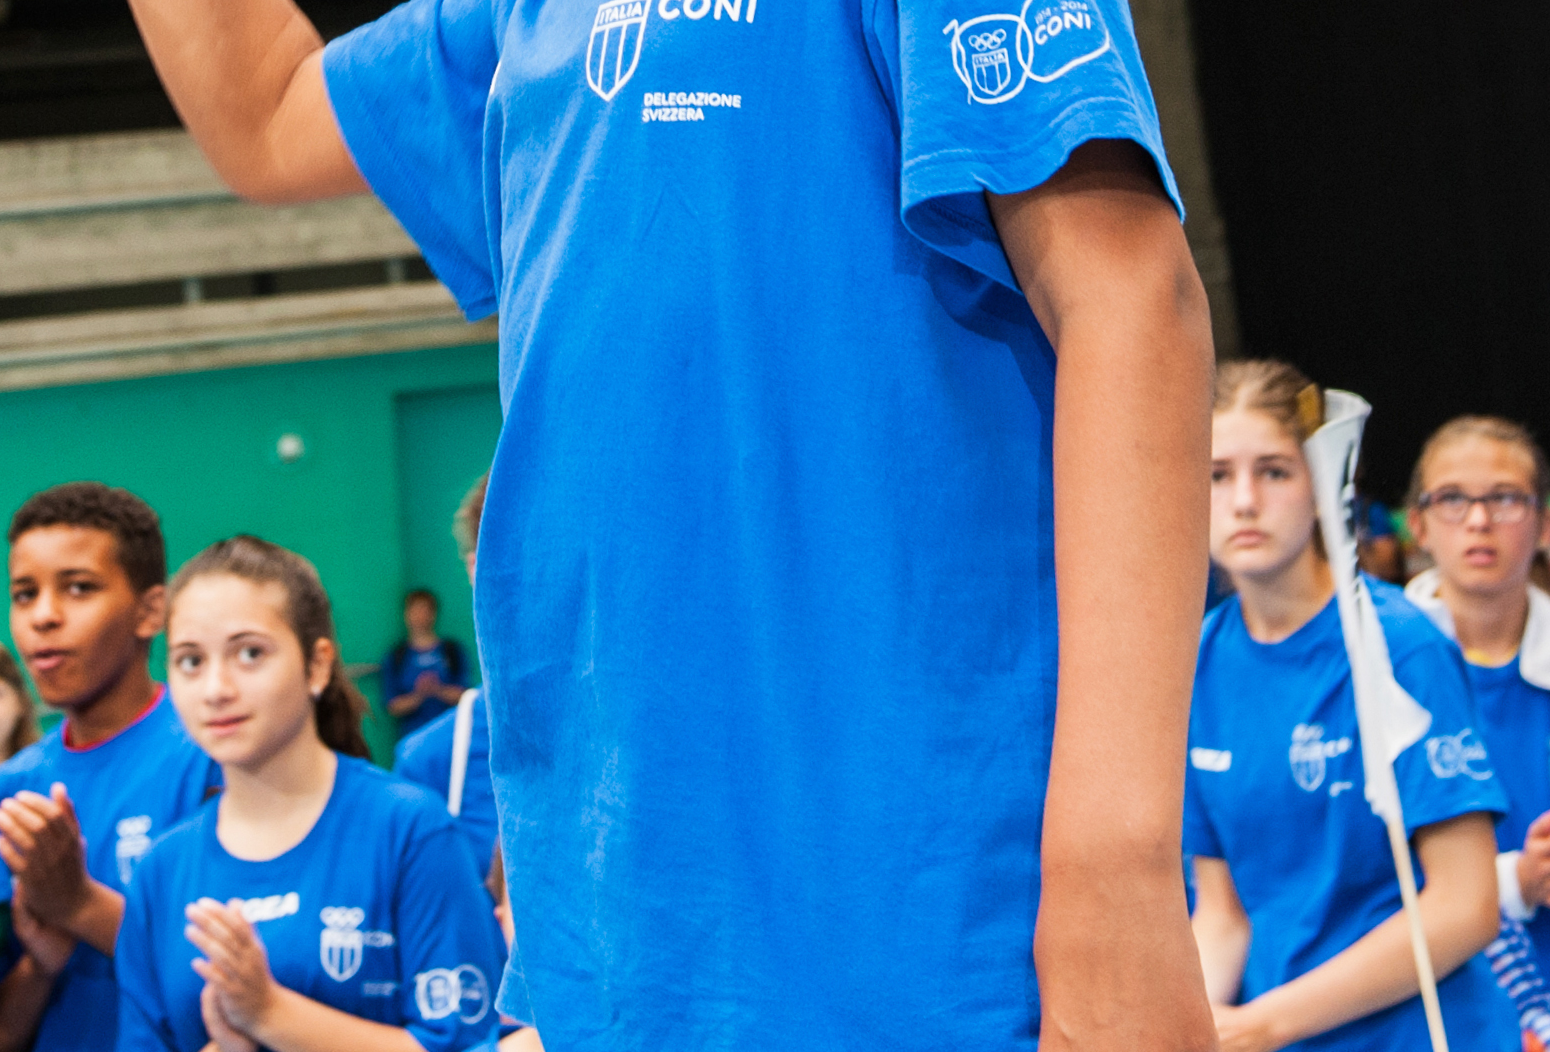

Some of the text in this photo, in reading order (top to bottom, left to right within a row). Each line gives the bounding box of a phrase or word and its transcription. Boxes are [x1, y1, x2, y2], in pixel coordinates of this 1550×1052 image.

[599, 1, 643, 24] ITALIA
[1034, 12, 1092, 46] CONI
[974, 52, 1006, 65] ITALIA
[643, 92, 742, 108] DELEGAZIONE
[642, 107, 705, 123] SVIZZERA
